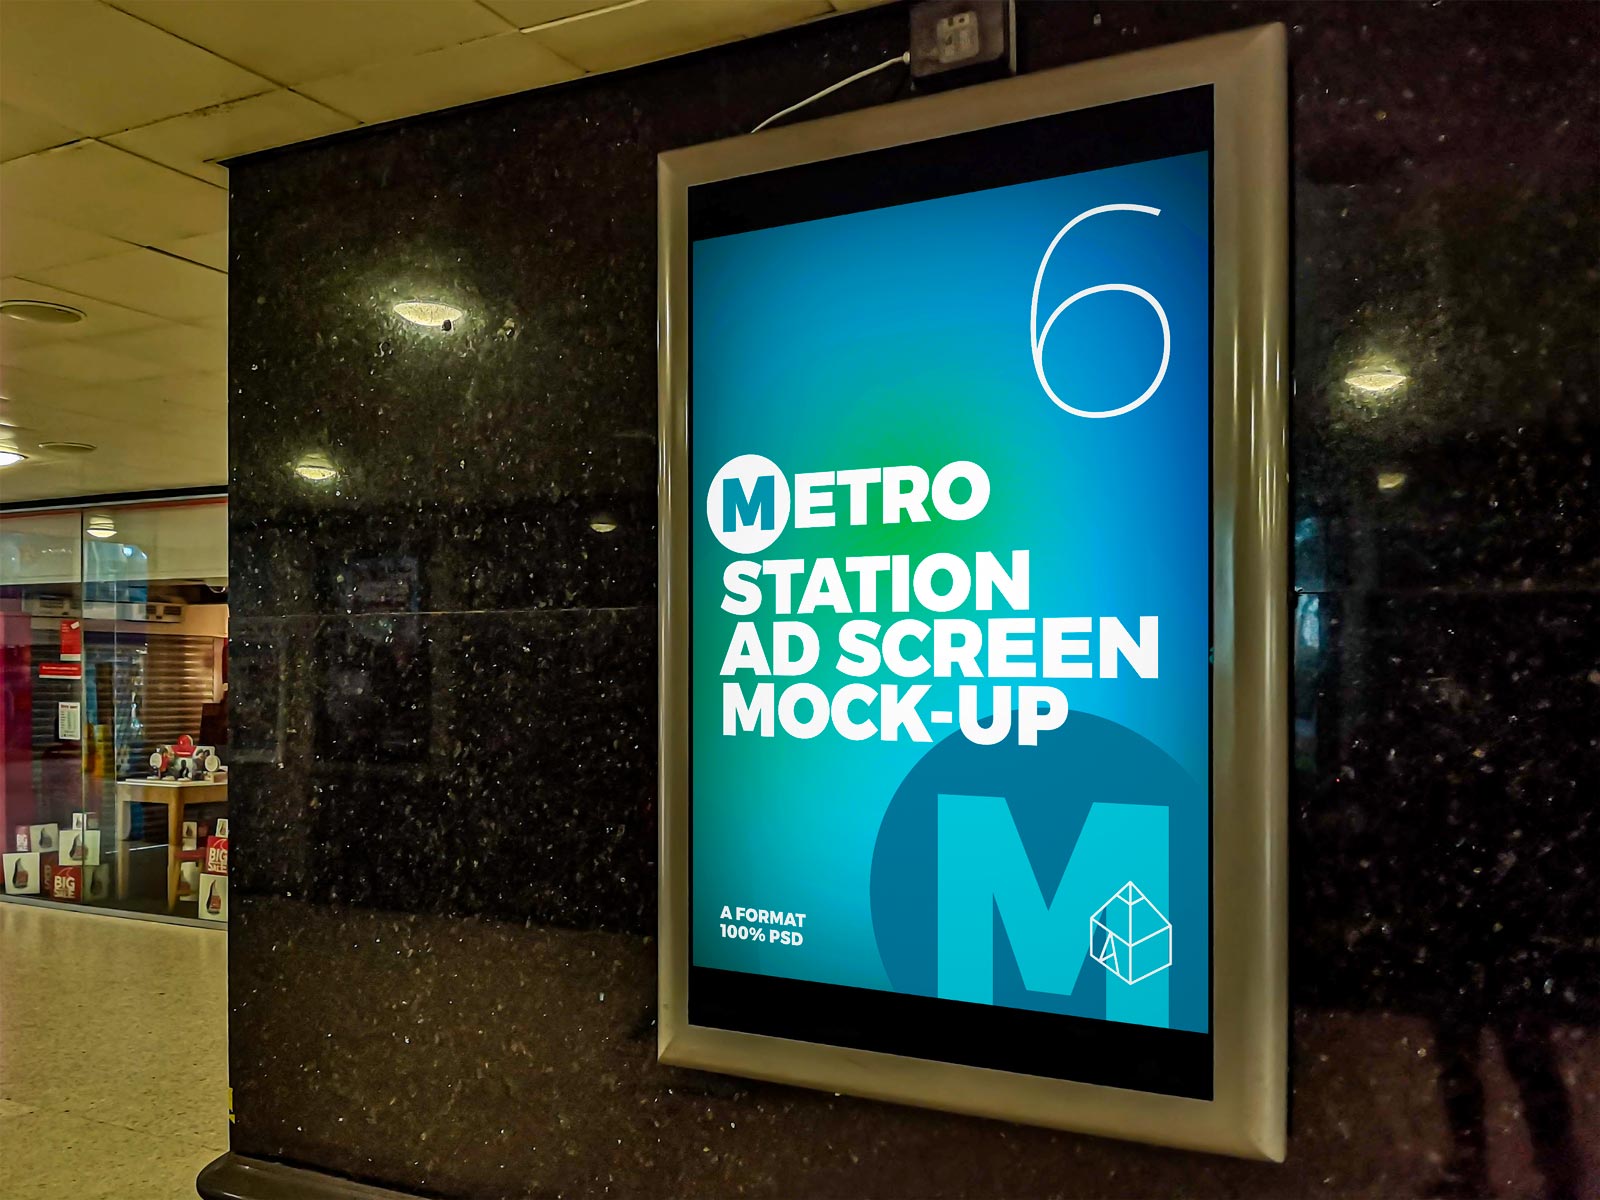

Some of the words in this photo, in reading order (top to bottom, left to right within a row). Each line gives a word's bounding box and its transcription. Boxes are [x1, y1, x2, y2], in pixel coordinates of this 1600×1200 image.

[1030, 203, 1171, 419] 6
[721, 459, 991, 534] METRO
[720, 549, 1030, 616] STATION
[719, 621, 820, 677] AD
[835, 615, 1159, 680] SCREEN
[722, 682, 1069, 747] MOCK-UP
[54, 875, 76, 888] BIG
[210, 847, 228, 862] BIG
[719, 905, 733, 920] A
[735, 906, 807, 928] FORMAT
[719, 923, 766, 942] 100%
[769, 929, 804, 947] PSD
[937, 793, 1170, 1029] M
